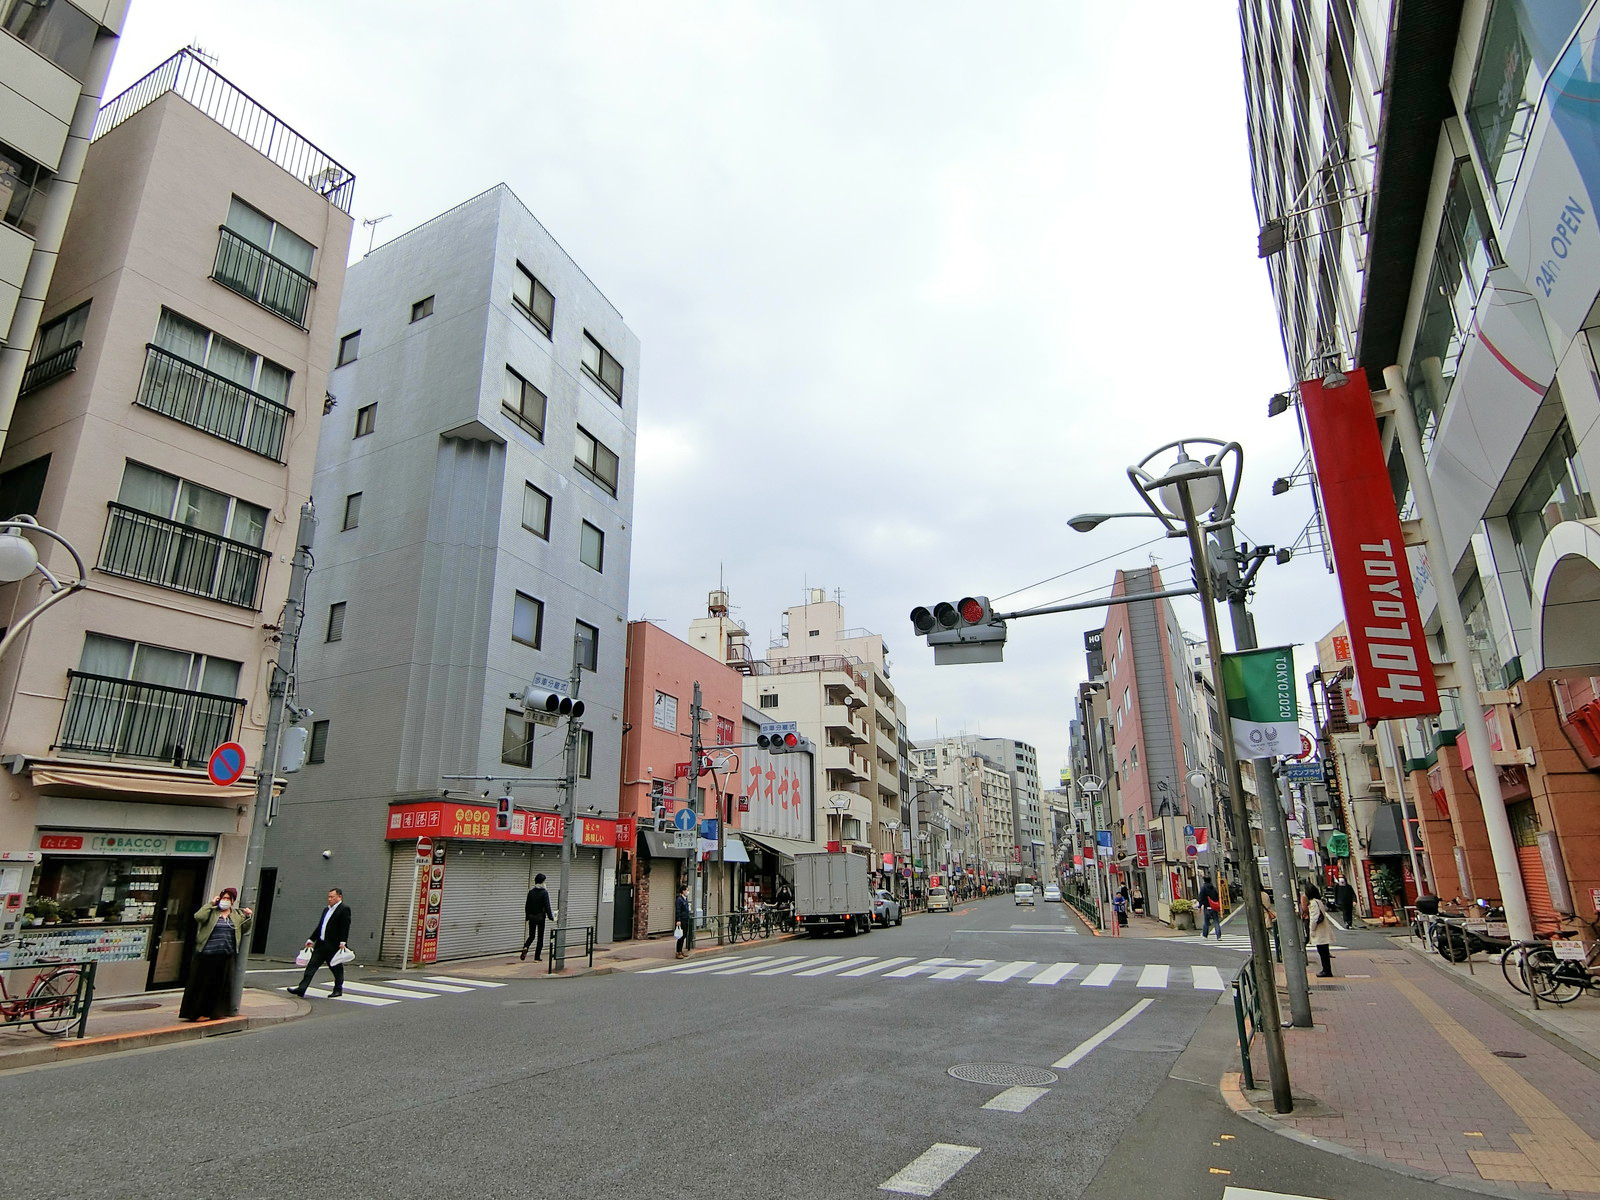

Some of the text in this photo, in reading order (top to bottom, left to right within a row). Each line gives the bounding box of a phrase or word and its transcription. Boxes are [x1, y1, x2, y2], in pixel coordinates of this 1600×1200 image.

[1536, 196, 1585, 297] 24h OPEN
[1088, 634, 1101, 643] HO
[1276, 657, 1292, 718] TOKYO 2020
[762, 724, 795, 732] 歩車分離式
[747, 757, 801, 820] オオゼキ
[404, 812, 439, 827] 香港亭
[454, 823, 490, 836] 小皿料理
[528, 817, 564, 838] 香港
[46, 838, 78, 848] たばこ
[100, 837, 162, 848] TOBACCO
